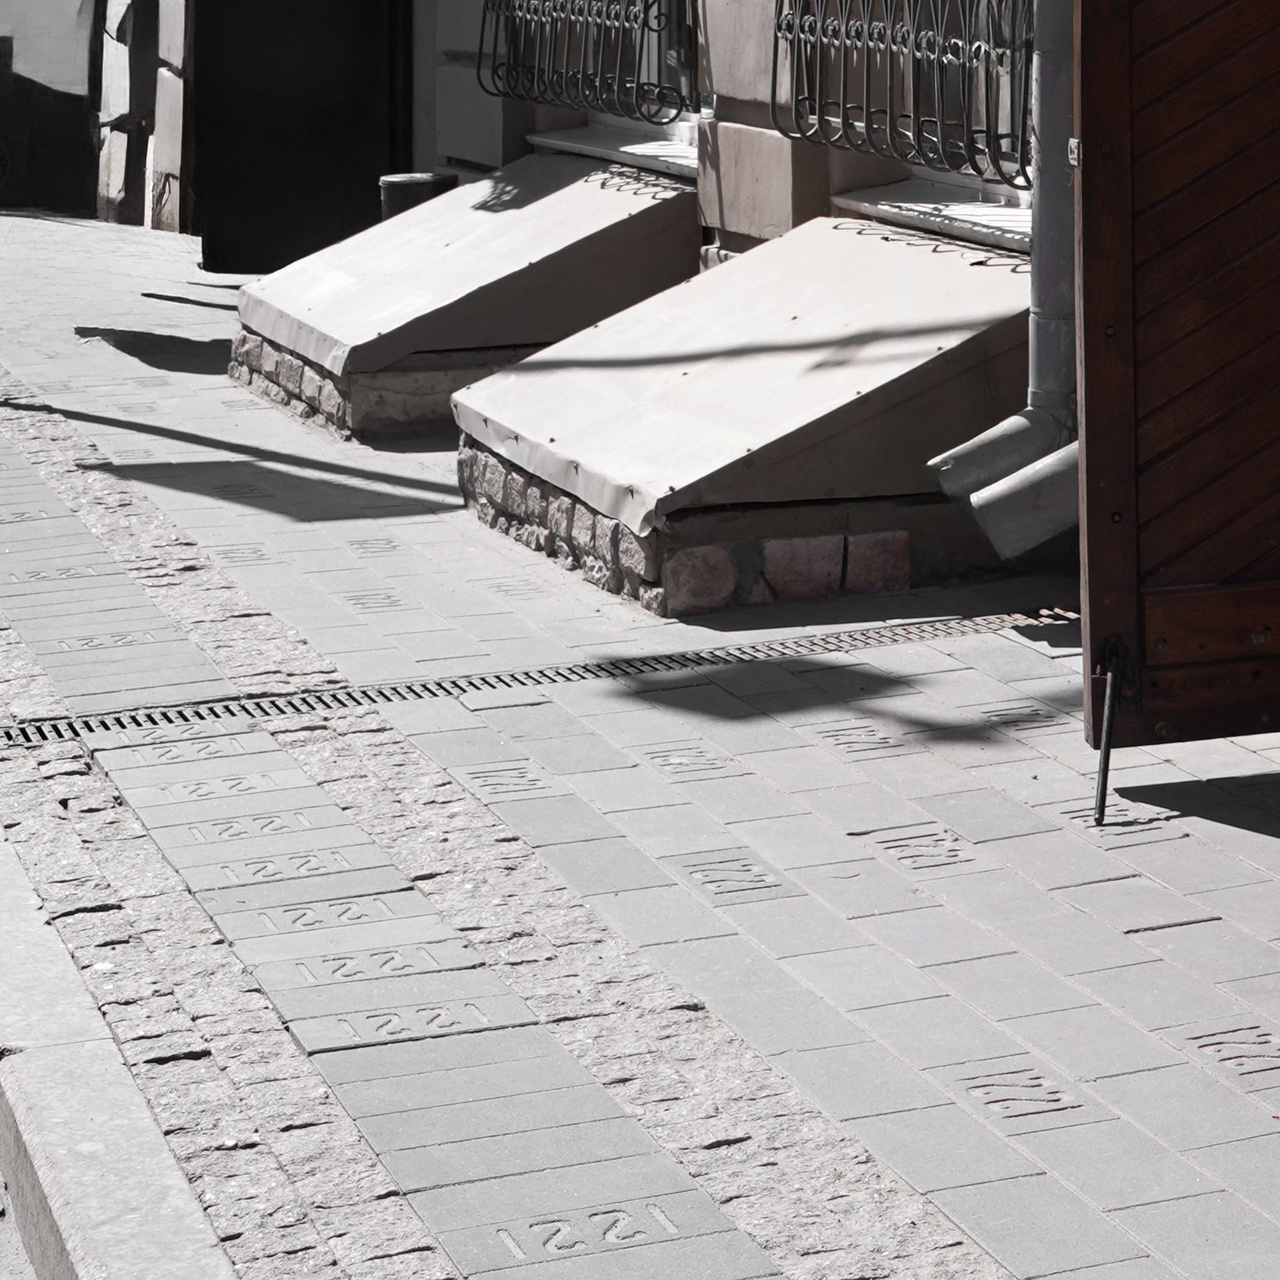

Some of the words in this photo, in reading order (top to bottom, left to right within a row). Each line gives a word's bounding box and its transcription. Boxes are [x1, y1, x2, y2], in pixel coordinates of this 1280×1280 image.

[188, 812, 313, 841] 1221
[221, 851, 352, 882] 1221
[257, 898, 396, 931] 1221
[296, 947, 440, 982] 1221
[337, 1002, 491, 1042] 1221
[496, 1202, 680, 1260] 1221
